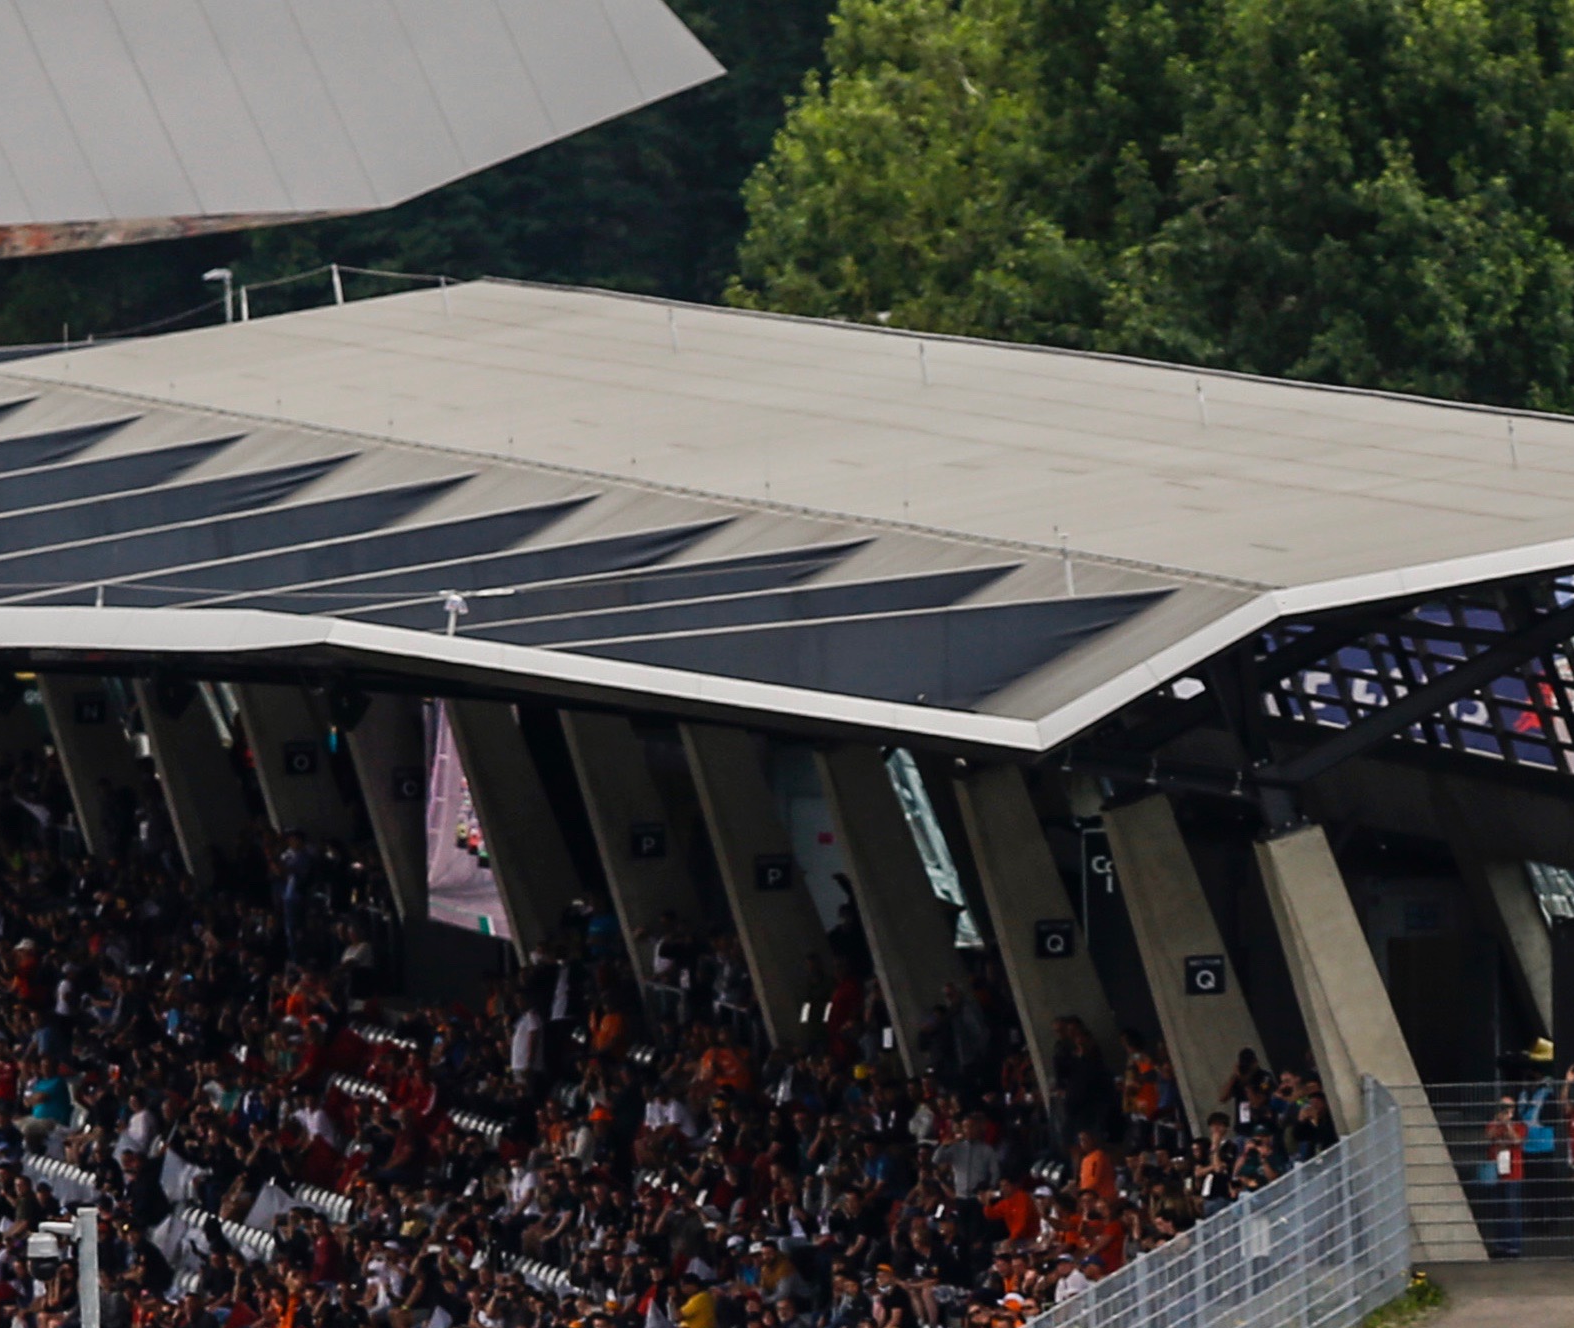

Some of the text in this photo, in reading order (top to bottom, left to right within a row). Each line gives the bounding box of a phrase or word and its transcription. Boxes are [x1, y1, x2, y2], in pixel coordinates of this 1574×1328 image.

[642, 836, 655, 853] P
[769, 867, 782, 884] P
[1046, 934, 1064, 952] Q
[1195, 969, 1215, 989] Q
